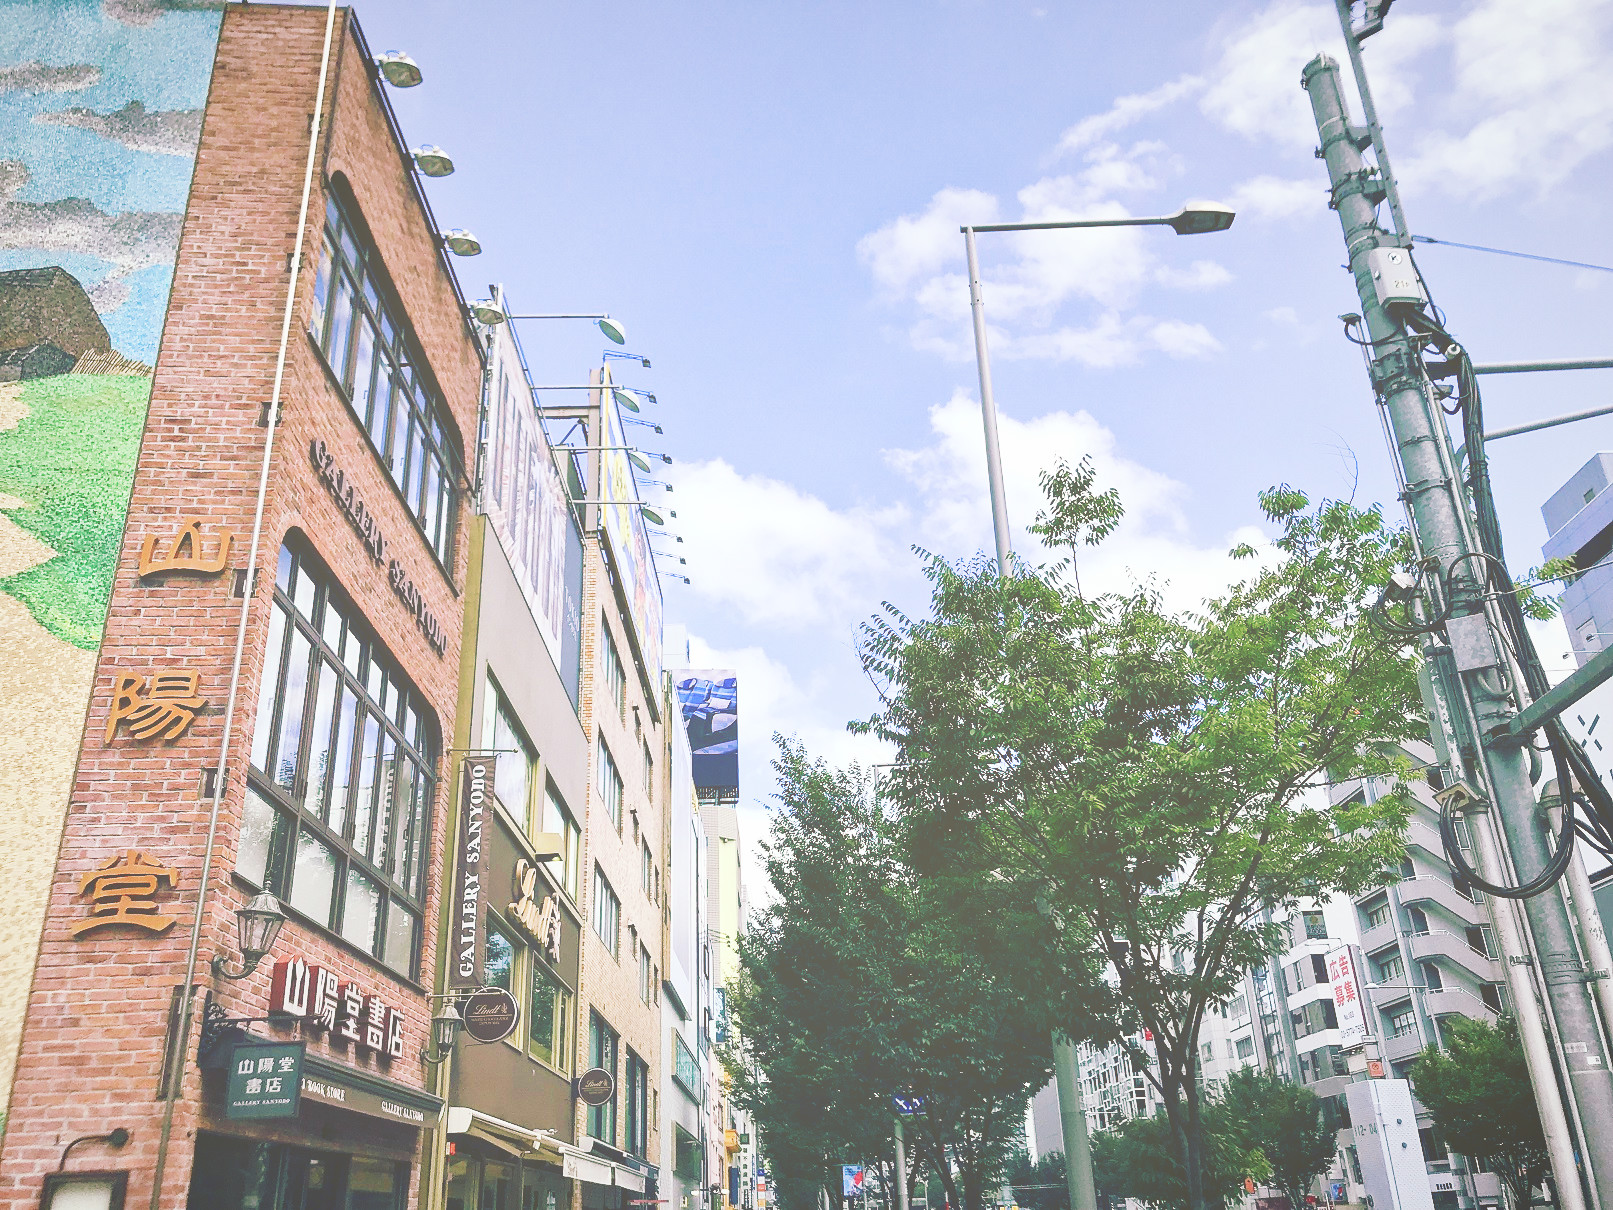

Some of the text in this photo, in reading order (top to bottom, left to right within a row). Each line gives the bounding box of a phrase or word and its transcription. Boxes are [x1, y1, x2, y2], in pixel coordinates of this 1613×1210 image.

[309, 440, 447, 659] GALLERY SANYODO
[71, 519, 236, 938] 山陽堂
[459, 764, 487, 977] GALLERY SANYODO
[1329, 955, 1350, 981] 広告
[282, 956, 405, 1058] 山陽堂書店
[1334, 981, 1356, 1007] 募集
[473, 1004, 502, 1015] Lindt
[238, 1057, 295, 1075] 山陽堂
[246, 1077, 283, 1094] 書店
[307, 1079, 326, 1098] BOOK
[326, 1086, 346, 1102] STORE
